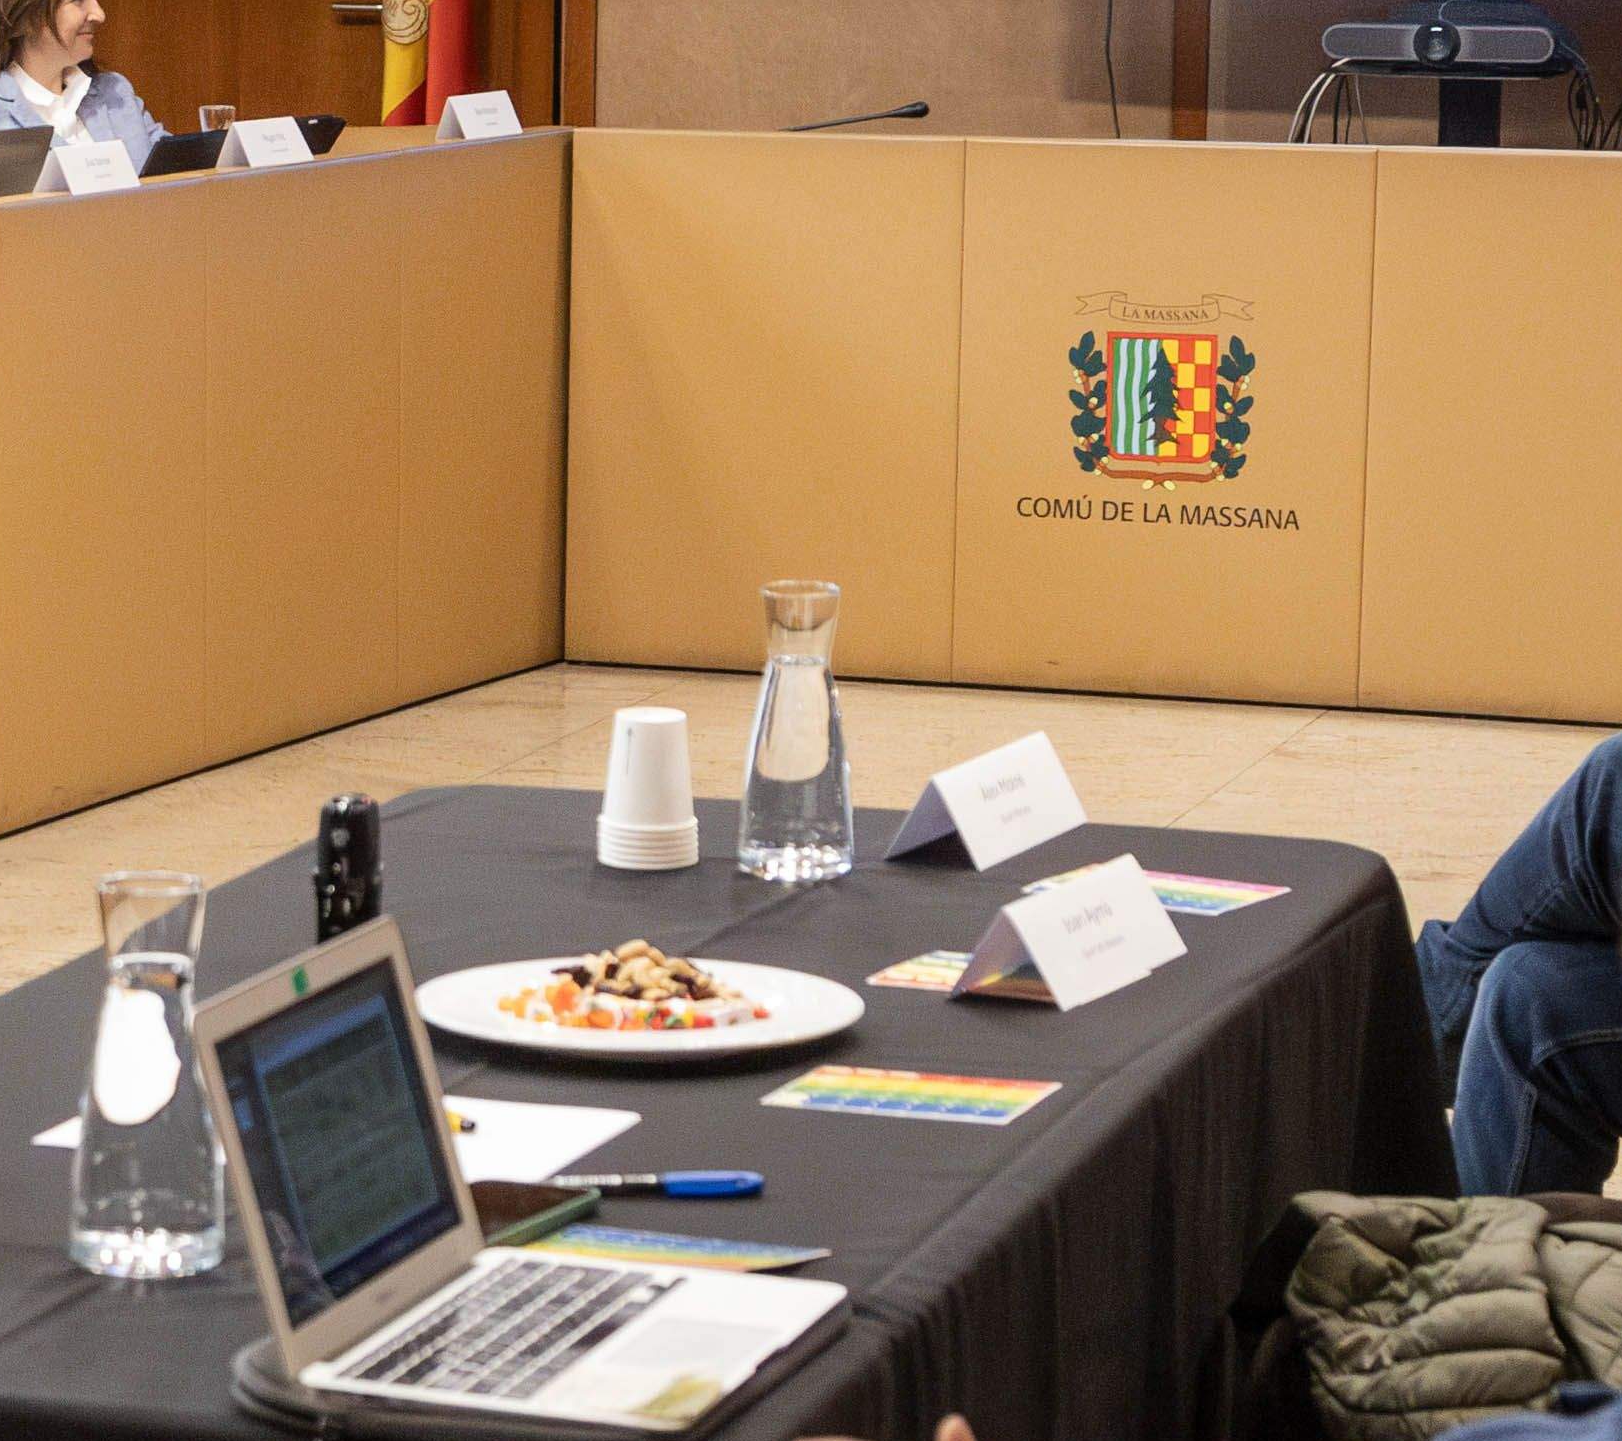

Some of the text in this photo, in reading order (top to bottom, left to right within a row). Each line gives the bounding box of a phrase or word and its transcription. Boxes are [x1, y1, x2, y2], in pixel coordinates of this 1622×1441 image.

[1122, 305, 1210, 322] LA MASSANA
[1016, 494, 1301, 531] COMÚ DE LA MASSANA
